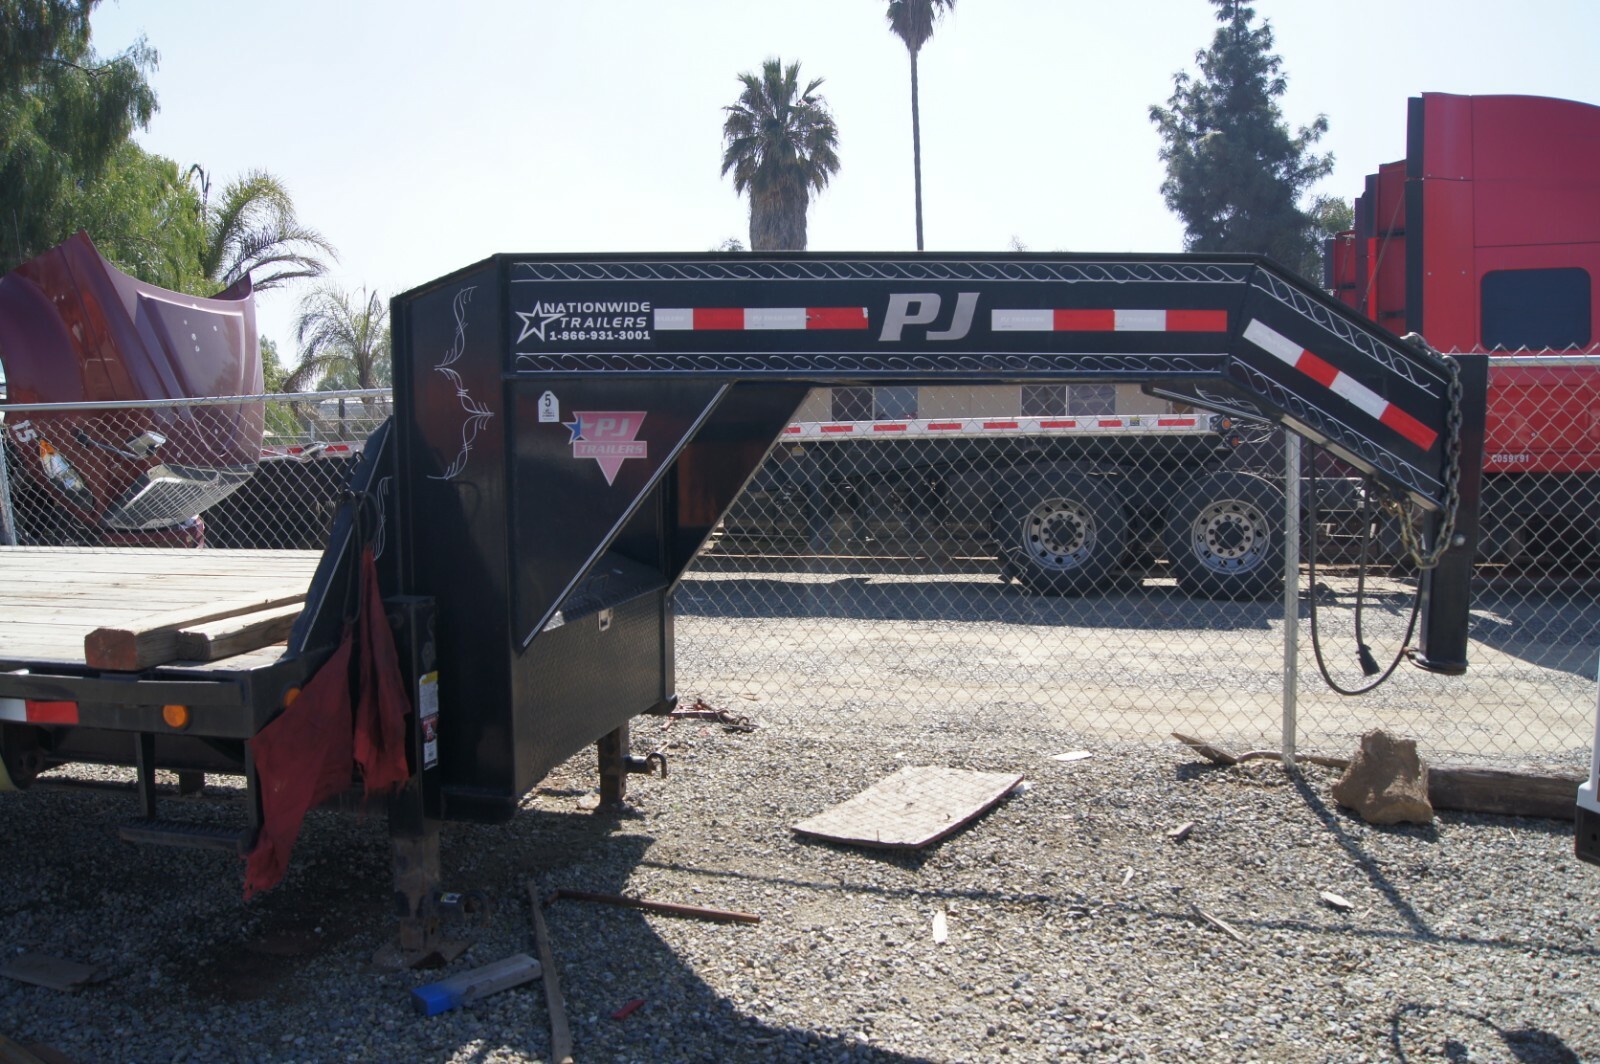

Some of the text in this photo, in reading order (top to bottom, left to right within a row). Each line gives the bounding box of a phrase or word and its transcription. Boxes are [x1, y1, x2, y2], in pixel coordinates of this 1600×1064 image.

[543, 302, 651, 313] NATIONWIDE
[559, 316, 647, 328] TRAILERS
[878, 292, 981, 342] PJ
[549, 330, 651, 341] 1-866-931-3001
[544, 394, 551, 407] 5
[12, 419, 37, 442] 15
[593, 418, 630, 437] PJ
[580, 444, 643, 454] TRAILERS
